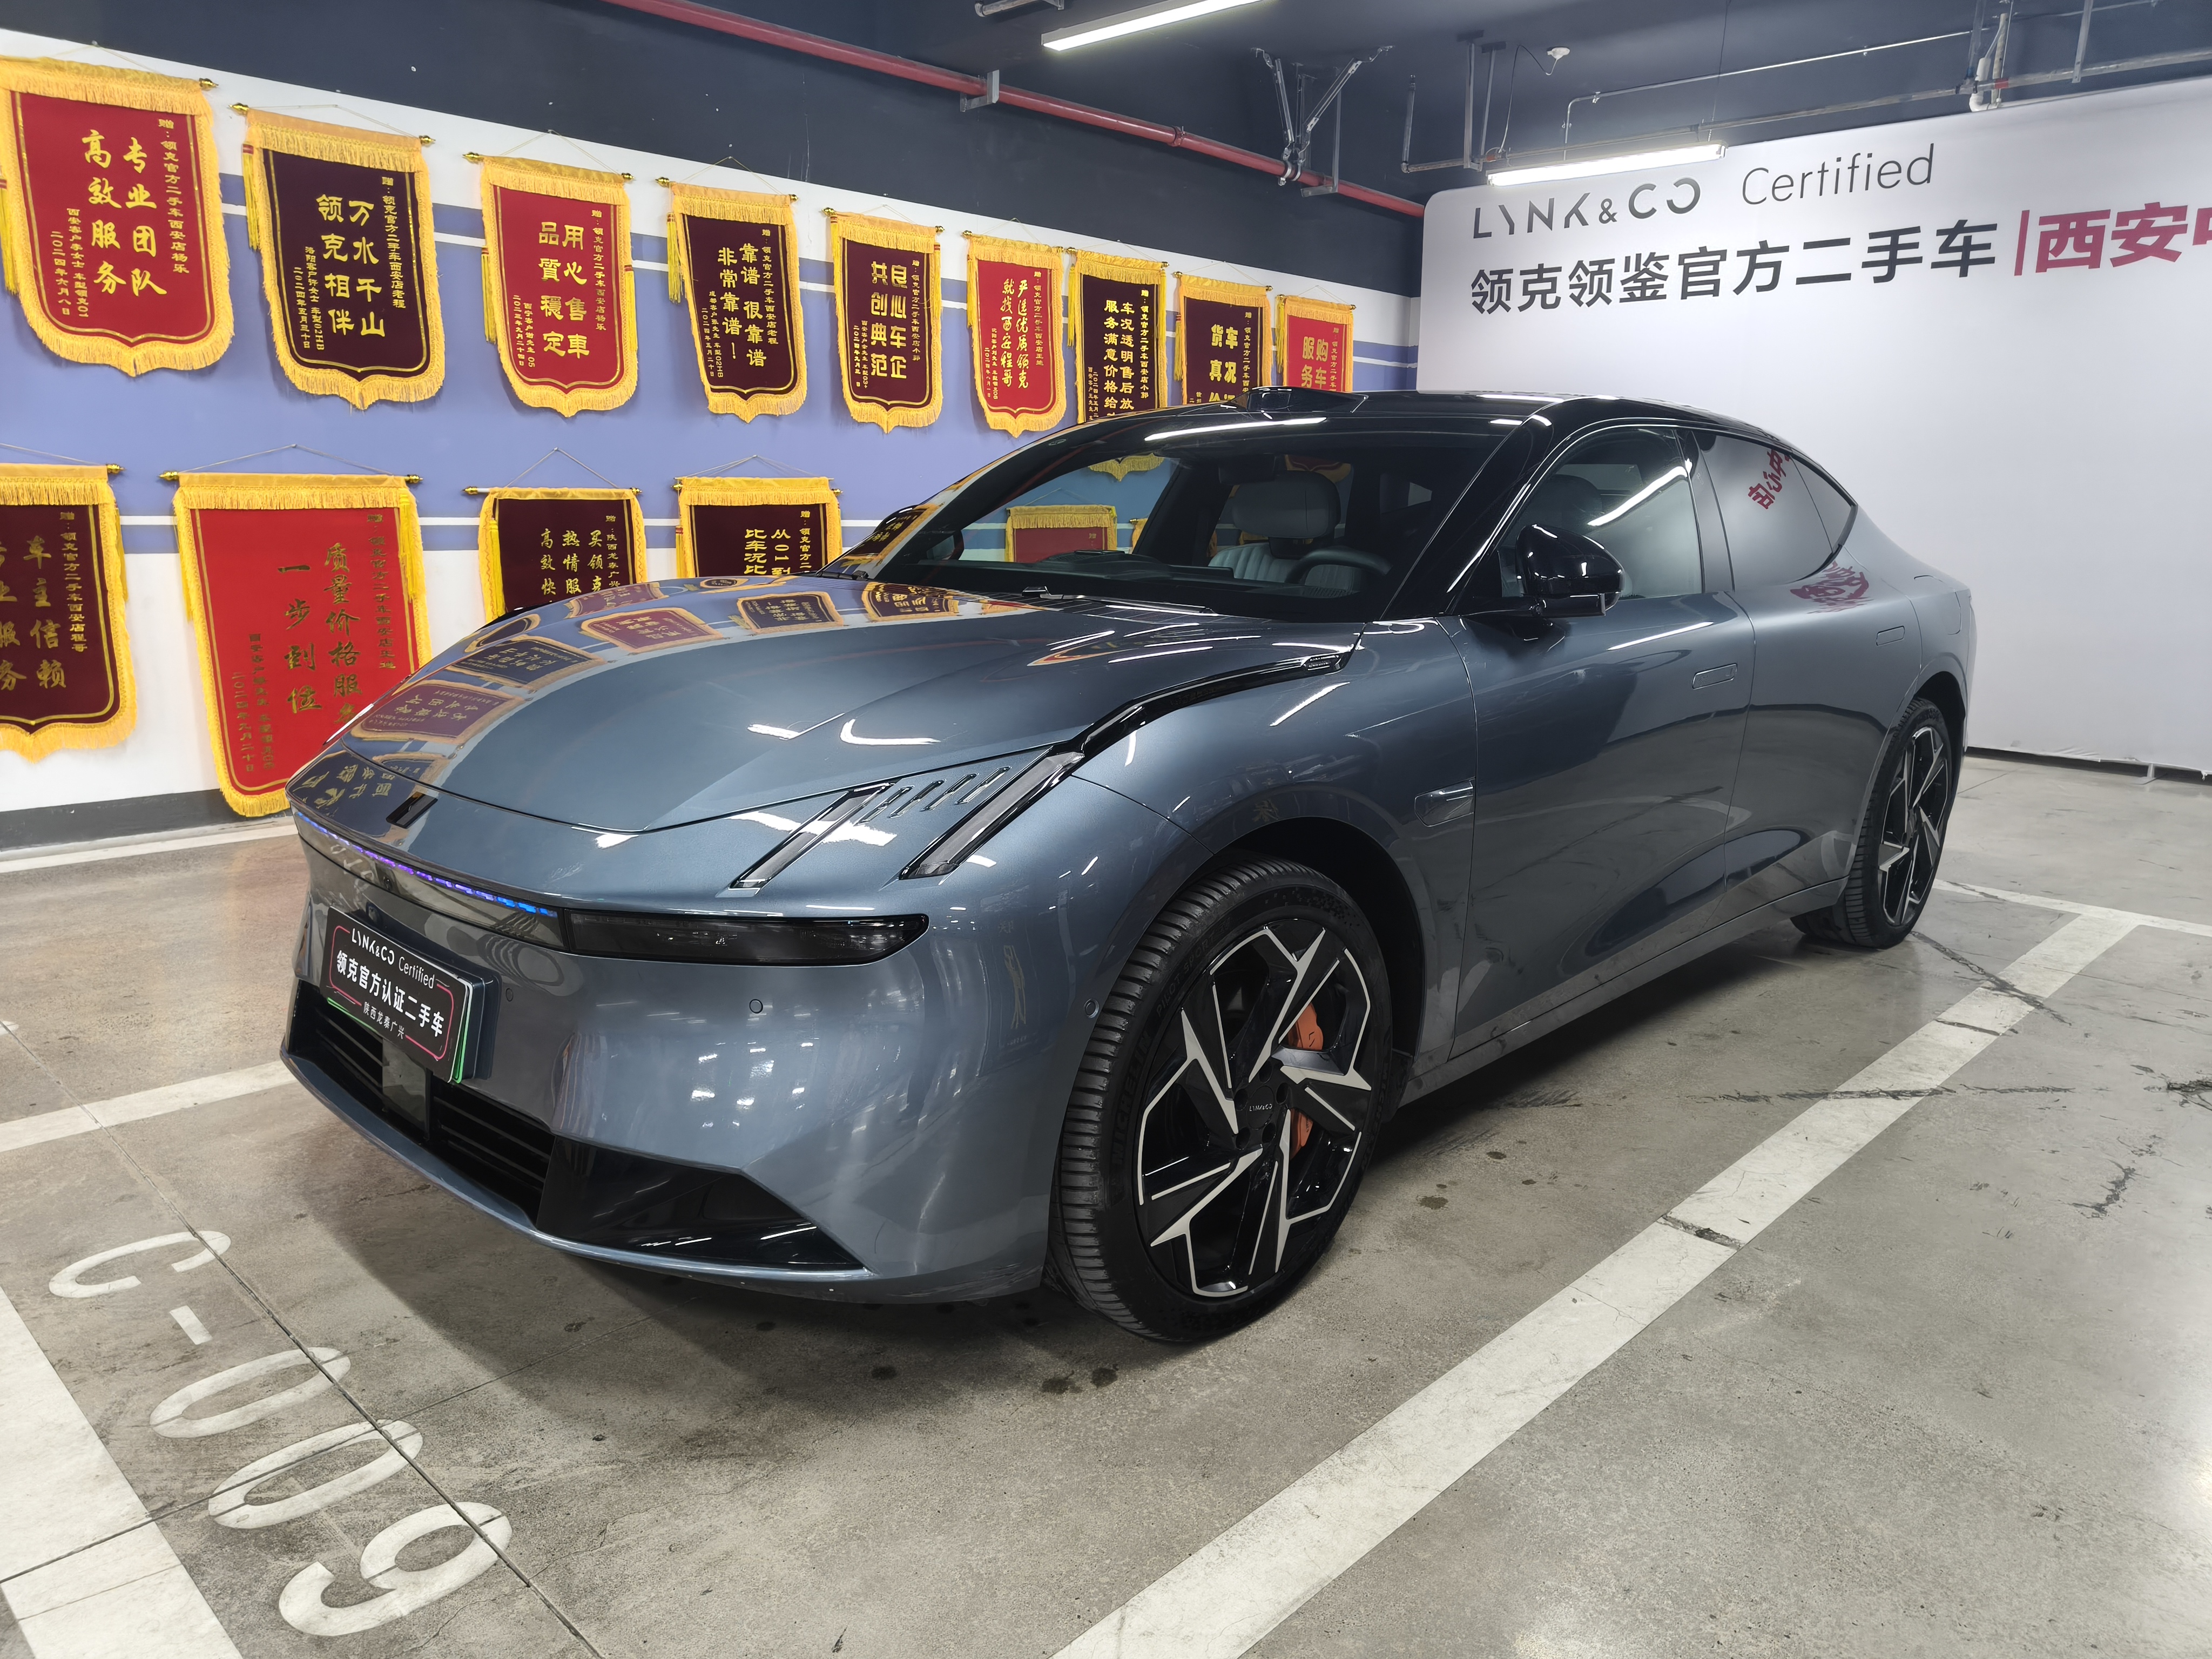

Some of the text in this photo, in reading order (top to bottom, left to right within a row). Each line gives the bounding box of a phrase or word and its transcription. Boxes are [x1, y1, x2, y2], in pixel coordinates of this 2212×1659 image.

[82, 130, 126, 295] 高效服务
[123, 137, 167, 296] 专业团队
[1473, 143, 1934, 239] LYNK&CO Certified
[316, 194, 354, 336] 领克相伴
[348, 200, 385, 338] 万水千山
[739, 243, 767, 367] 靠谱 很靠谱
[870, 261, 888, 377] 共创典范
[1471, 219, 1998, 315] 领克领鉴官方二手车
[1000, 278, 1015, 387] 就找西安程哥
[1016, 279, 1029, 389] 严选优质领克
[1103, 299, 1120, 416] 服务满意价格给
[1120, 302, 1135, 410] 车况透明售后放
[1301, 336, 1315, 388] 服务
[1314, 339, 1329, 389] 购车
[540, 528, 556, 603] 高效快
[562, 530, 582, 595] 热情服
[744, 529, 767, 575] 比车况比
[0, 540, 27, 691] 服务
[278, 563, 322, 714] 一步到位
[336, 950, 444, 1037] 领克官方认证二手车
[352, 928, 435, 989] LYNK&CO Certified
[49, 1230, 512, 1636] C-009
